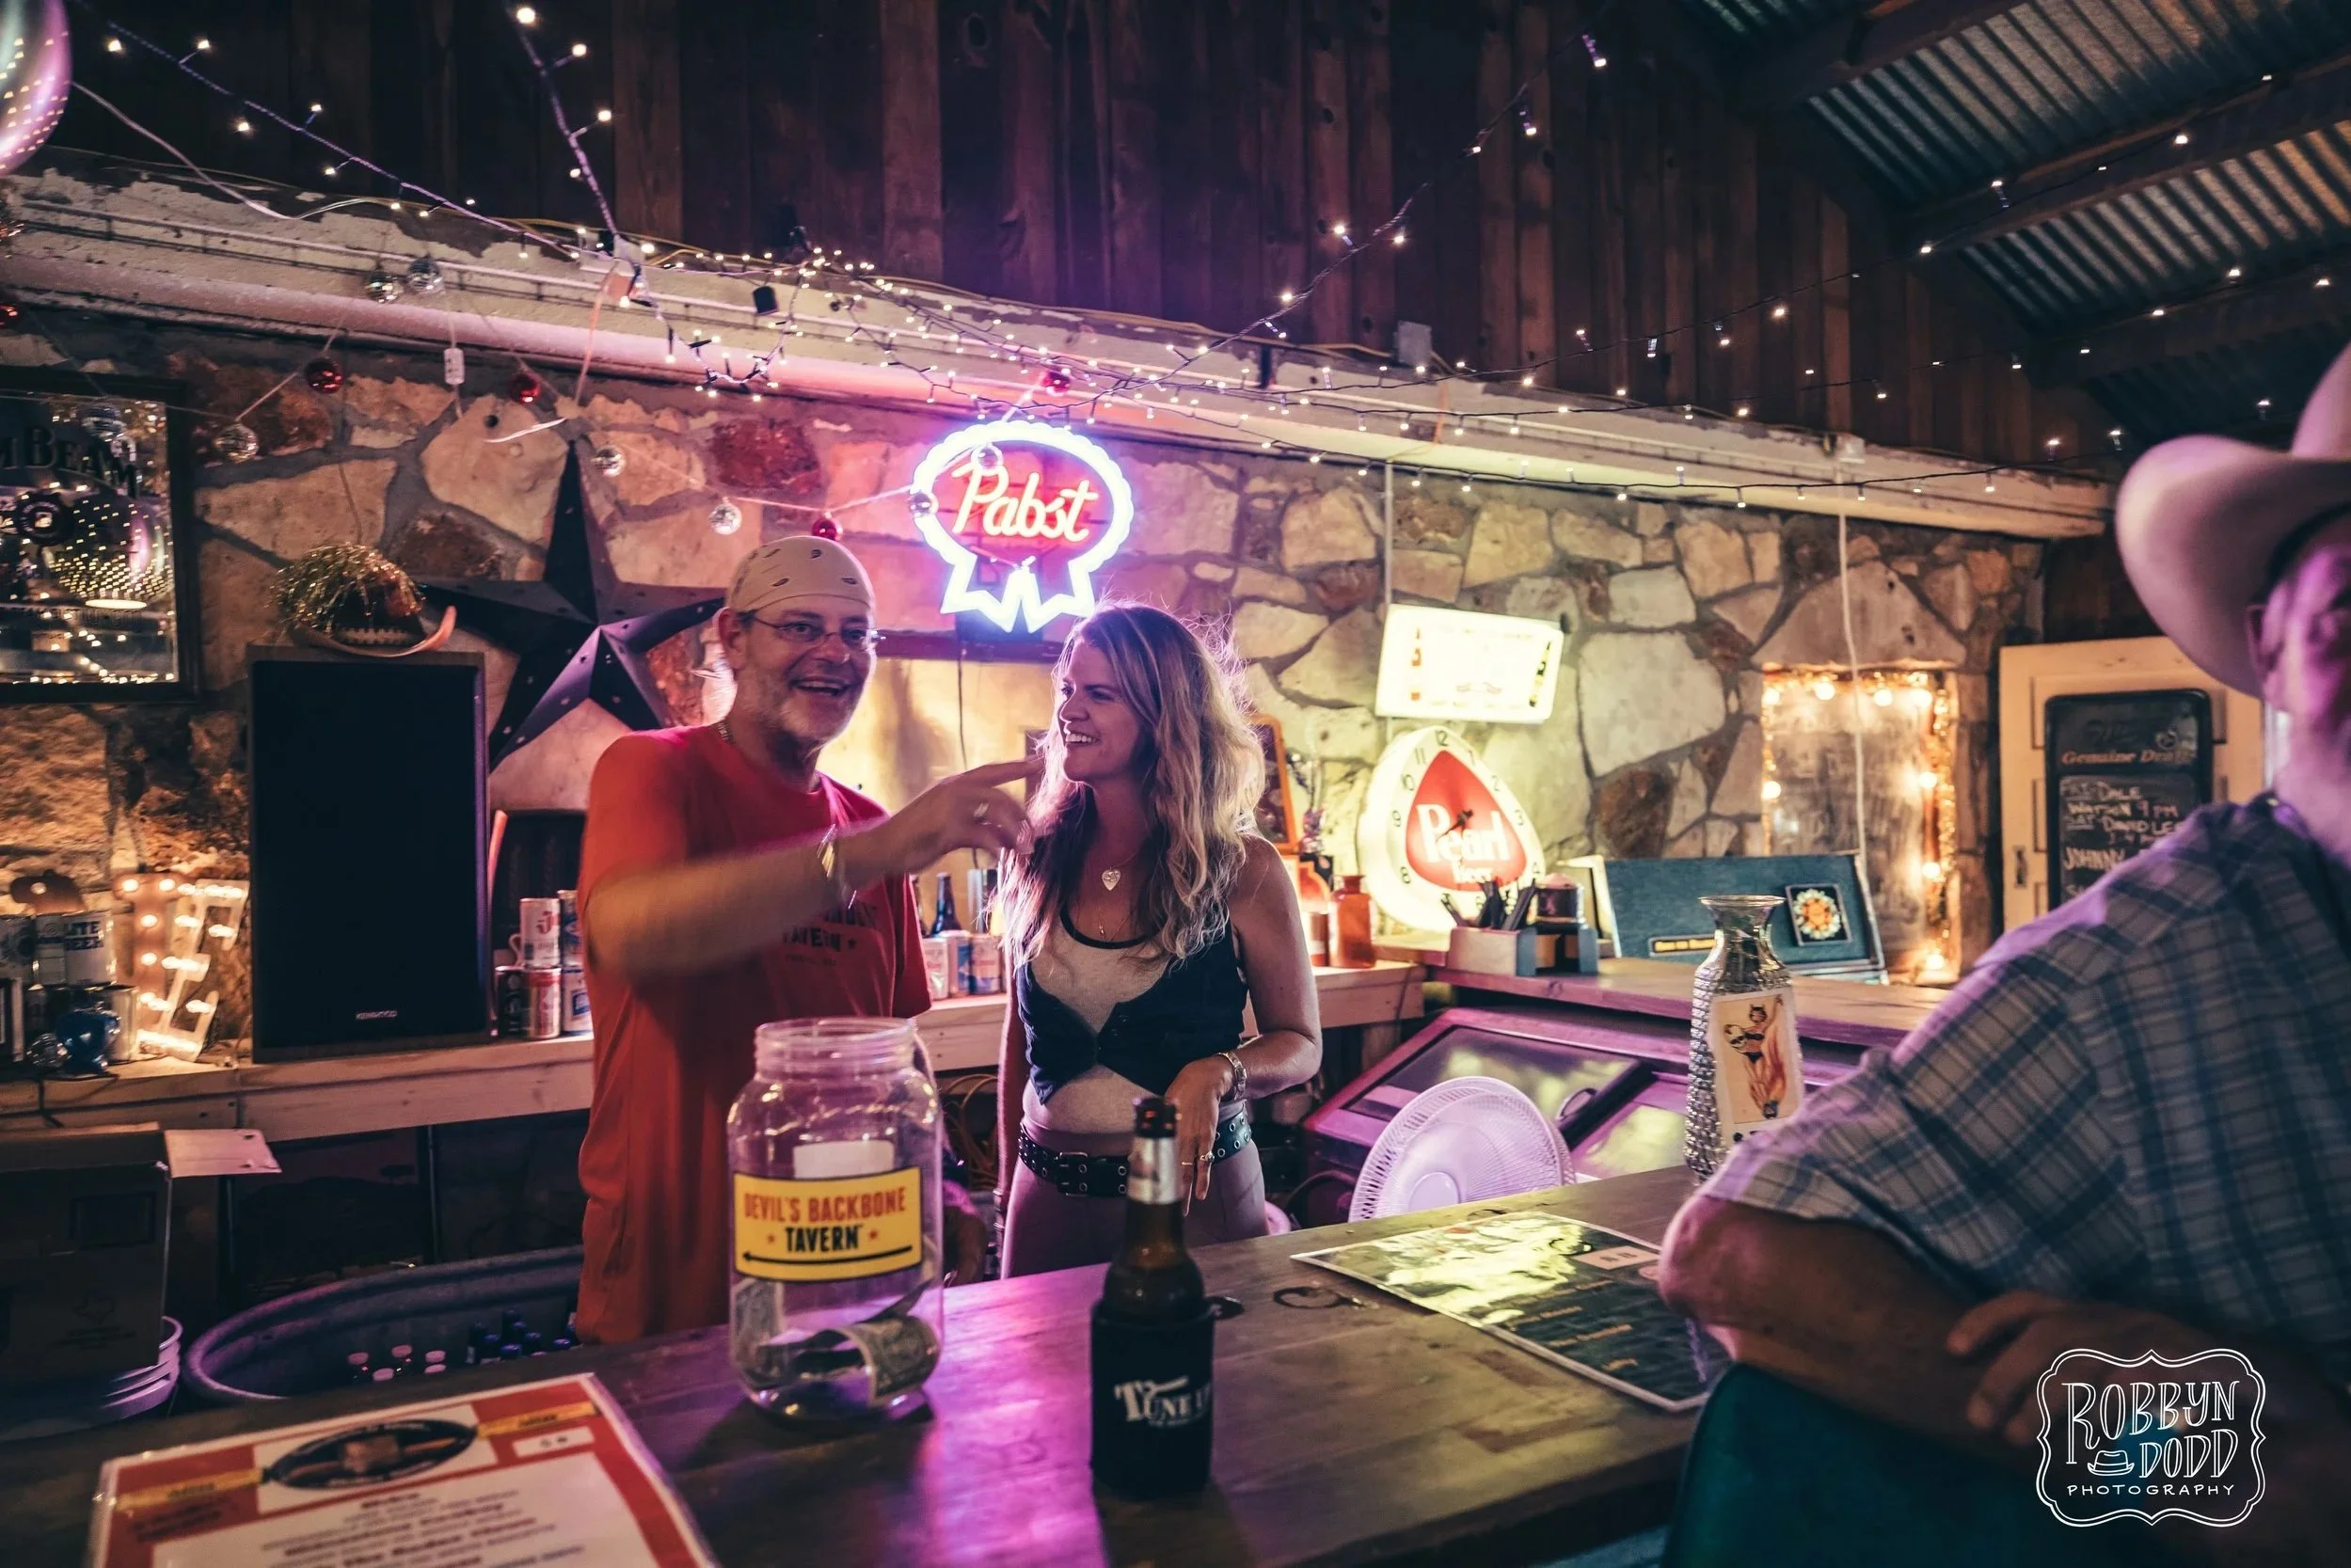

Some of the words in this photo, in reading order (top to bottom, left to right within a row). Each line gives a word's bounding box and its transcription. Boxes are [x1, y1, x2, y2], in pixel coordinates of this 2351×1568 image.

[951, 460, 1099, 542] Pabst
[1416, 803, 1511, 863] Pearl
[356, 1010, 398, 1020] KENWOOD
[743, 1193, 801, 1223] DEVIL'S
[807, 1186, 906, 1223] BACKBONE
[785, 1224, 860, 1253] TAVERN
